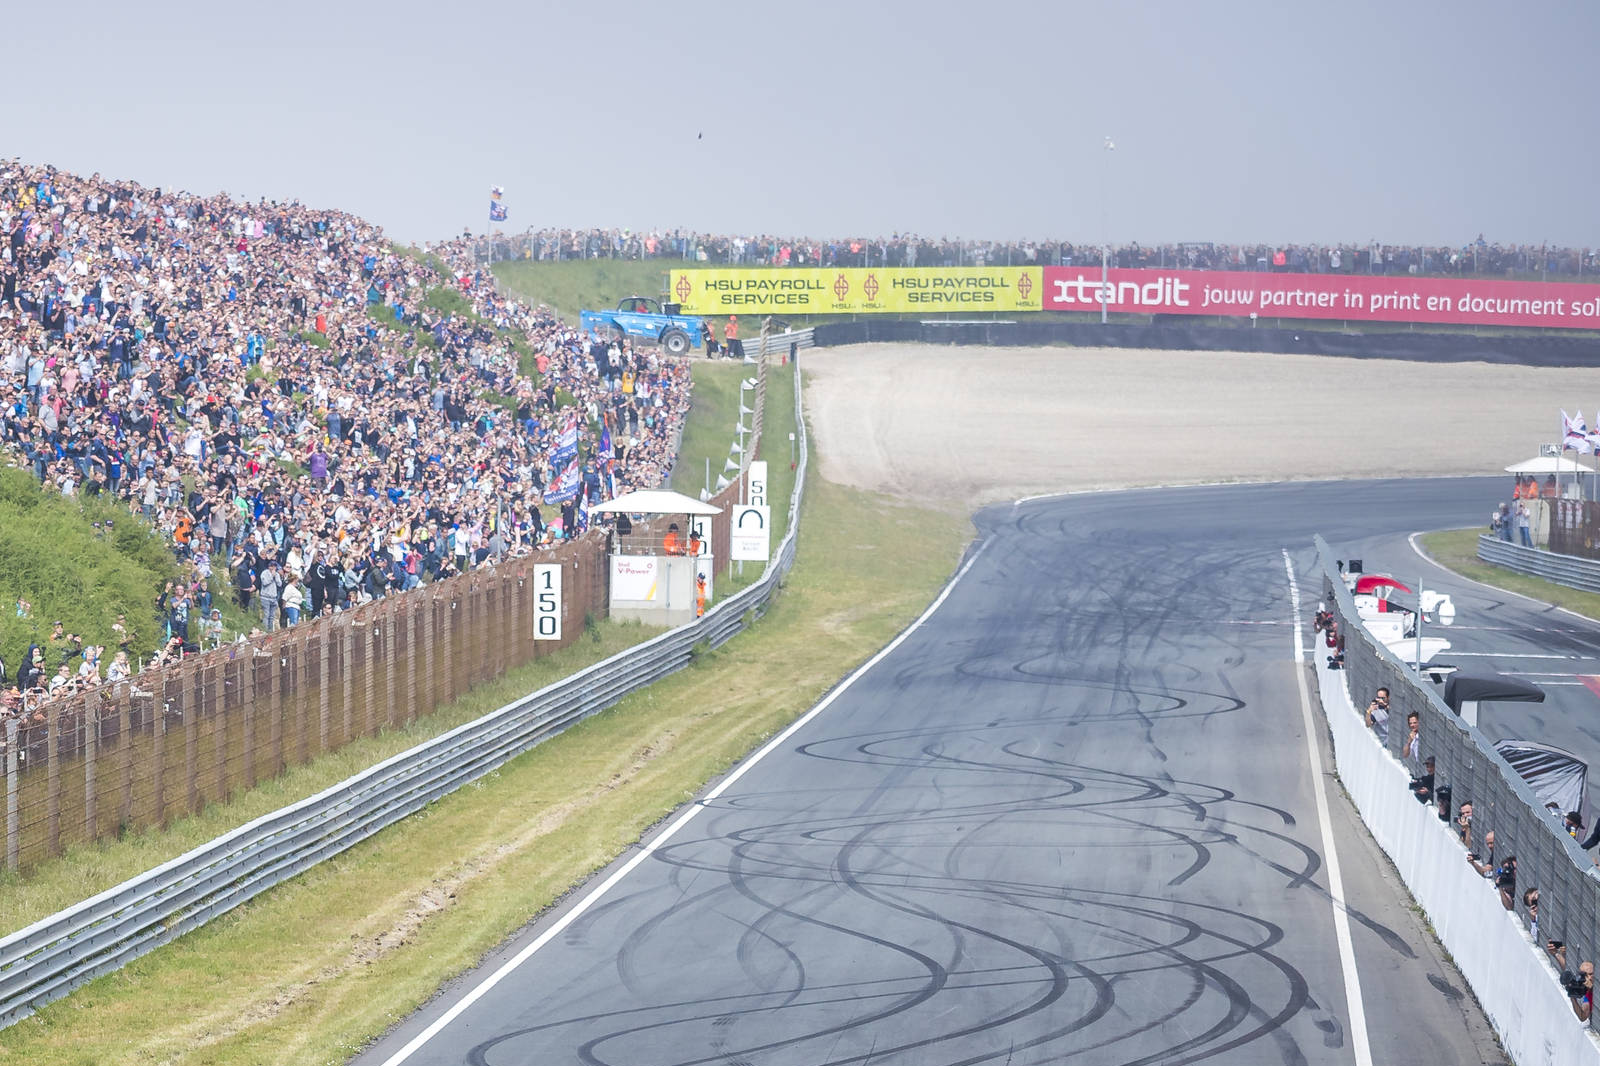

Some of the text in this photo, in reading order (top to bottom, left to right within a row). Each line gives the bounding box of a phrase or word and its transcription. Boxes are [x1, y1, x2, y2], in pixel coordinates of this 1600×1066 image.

[705, 279, 824, 290] HSU PAYROLL
[893, 277, 1010, 288] HSU PAYROLL
[1053, 275, 1190, 306] xtandit
[721, 294, 810, 304] SERVICES
[907, 291, 995, 303] SERVICES
[1201, 285, 1254, 307] jouw
[1260, 288, 1339, 308] partner
[1344, 289, 1363, 308] in
[1370, 291, 1420, 312] print
[1426, 297, 1450, 312] en
[1458, 294, 1565, 316] document
